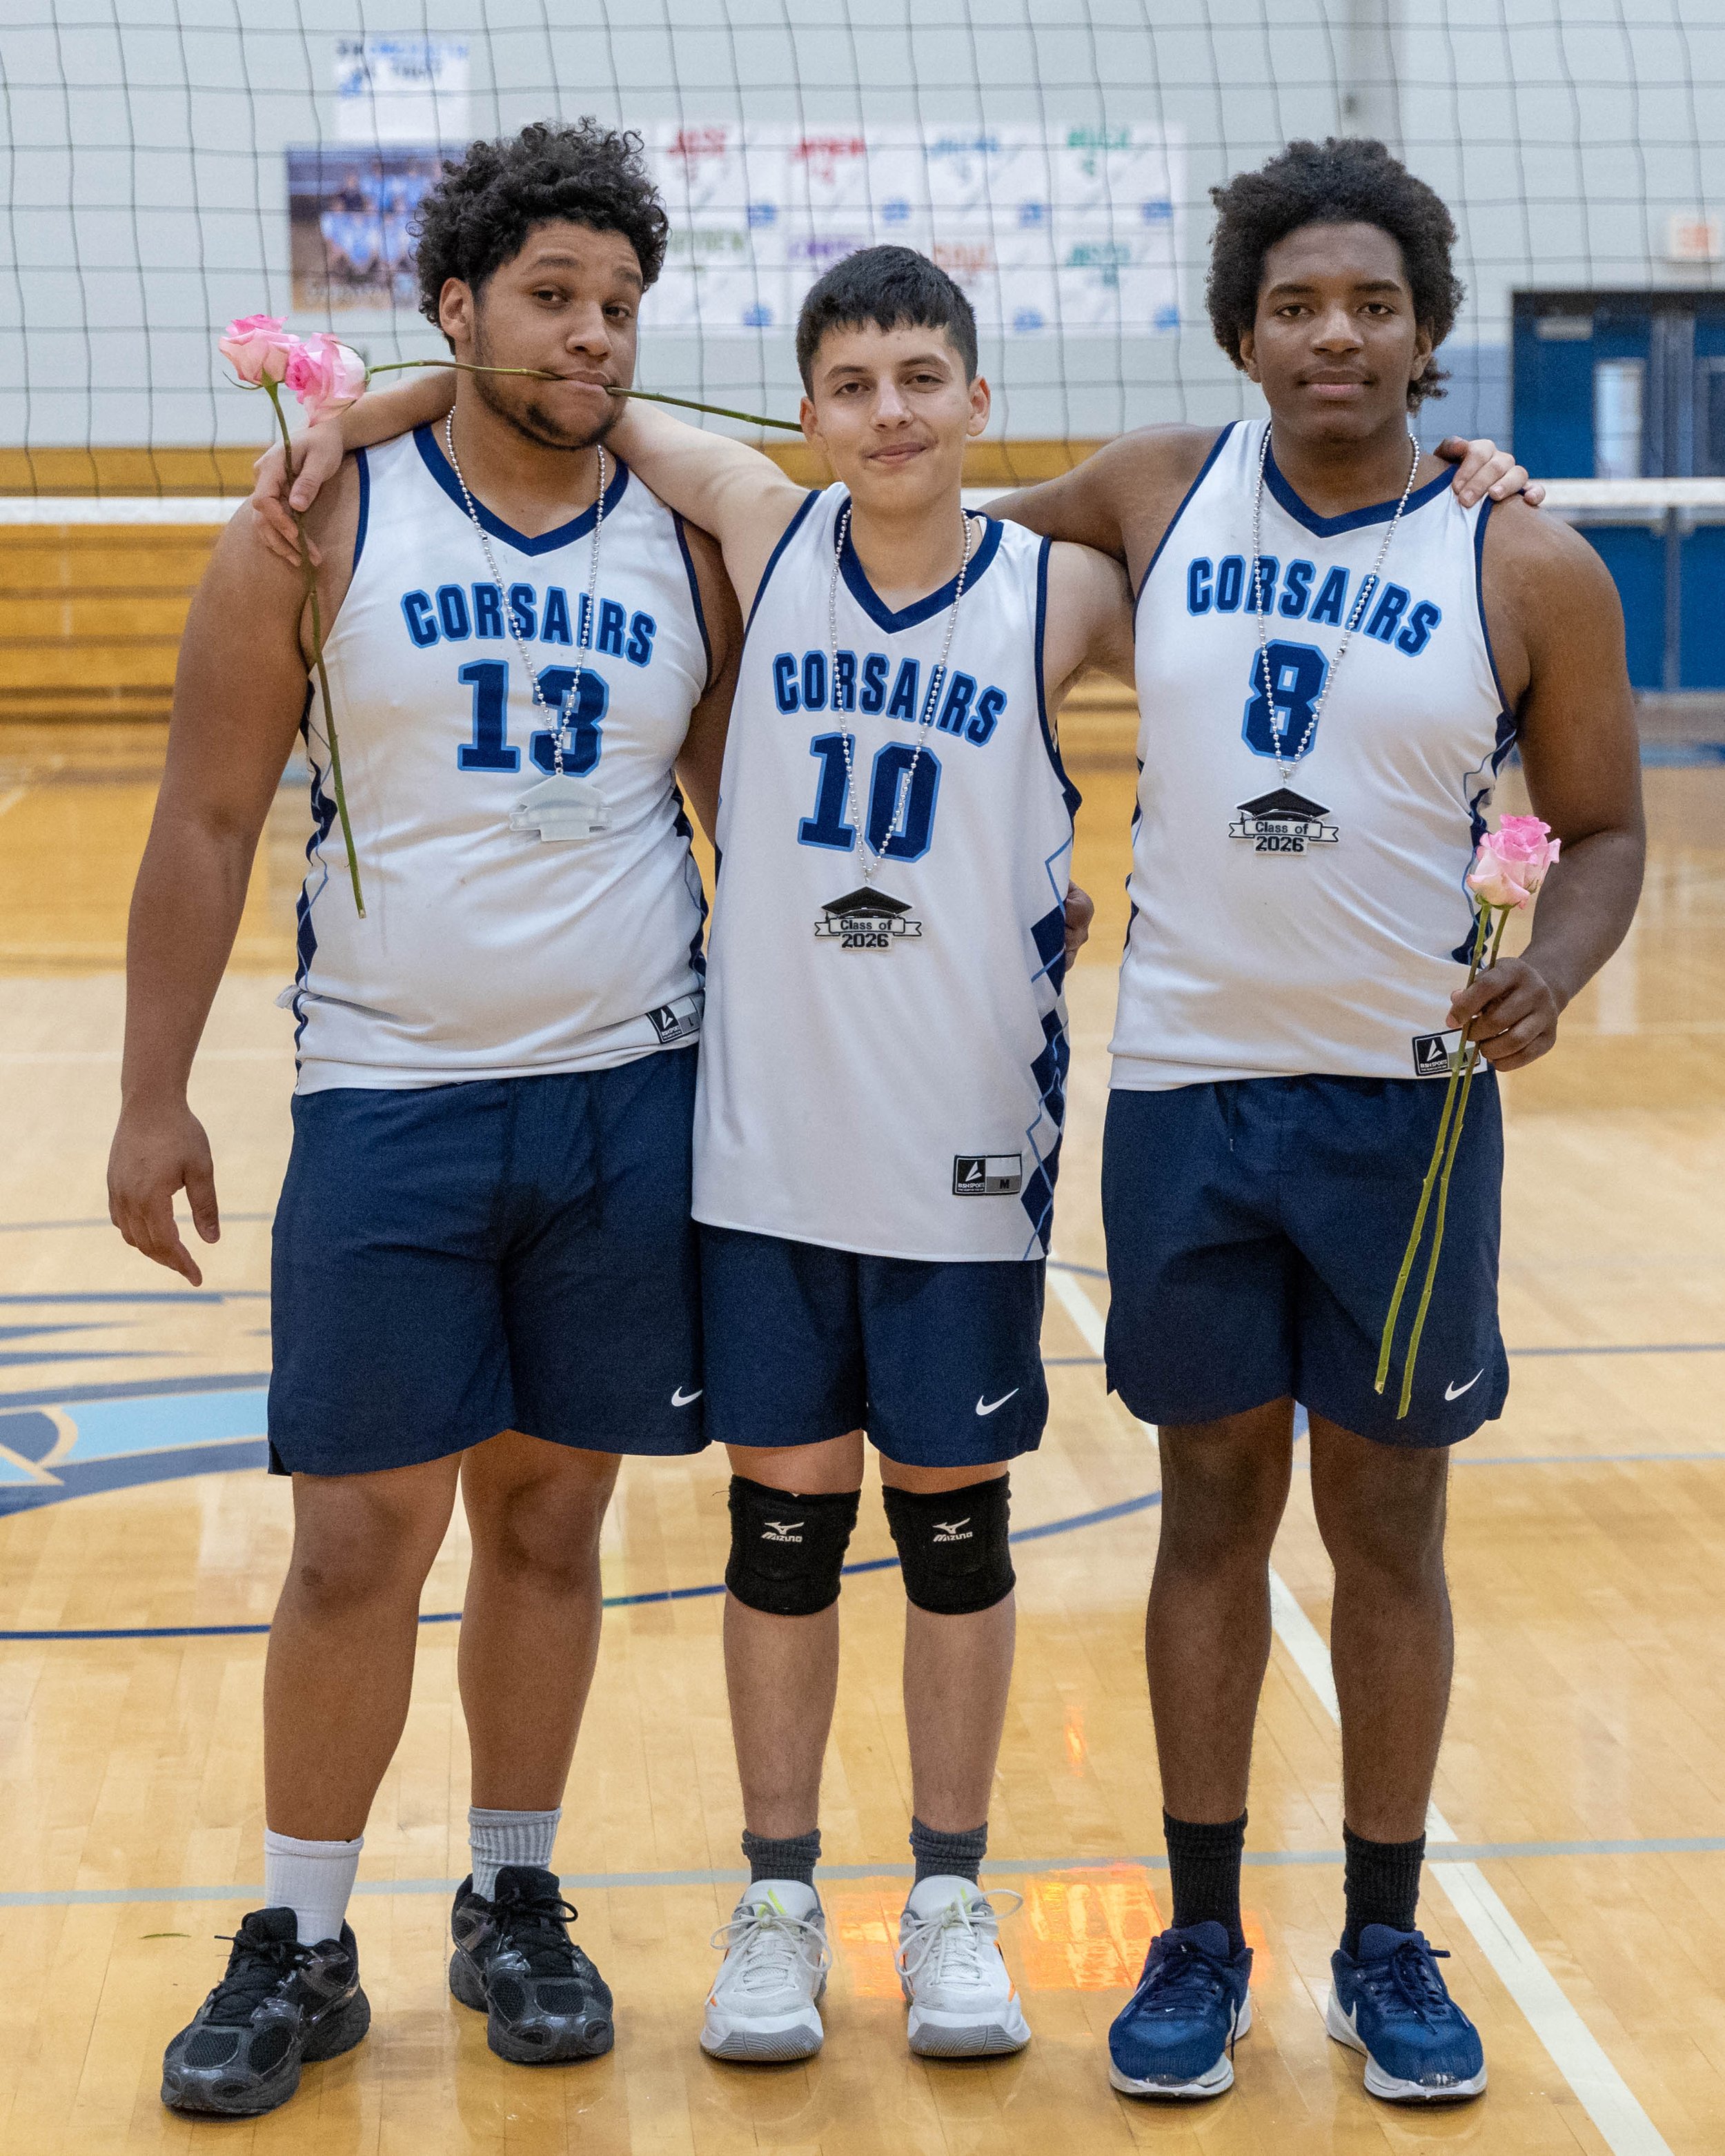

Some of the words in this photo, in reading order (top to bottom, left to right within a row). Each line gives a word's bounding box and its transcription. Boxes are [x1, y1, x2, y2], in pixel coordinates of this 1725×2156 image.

[400, 582, 657, 667] CORSAIRS
[1187, 555, 1442, 657] CORSAIRS
[457, 658, 609, 778] 13
[772, 650, 1007, 747] CORSAIRS
[1241, 639, 1330, 762] 8
[798, 731, 942, 863] 10
[1255, 822, 1288, 833] Class
[1295, 824, 1309, 835] of
[1256, 835, 1304, 852] 2026
[840, 920, 872, 930] Class
[878, 920, 892, 930] of
[842, 933, 889, 948] 2026
[999, 1179, 1009, 1189] M
